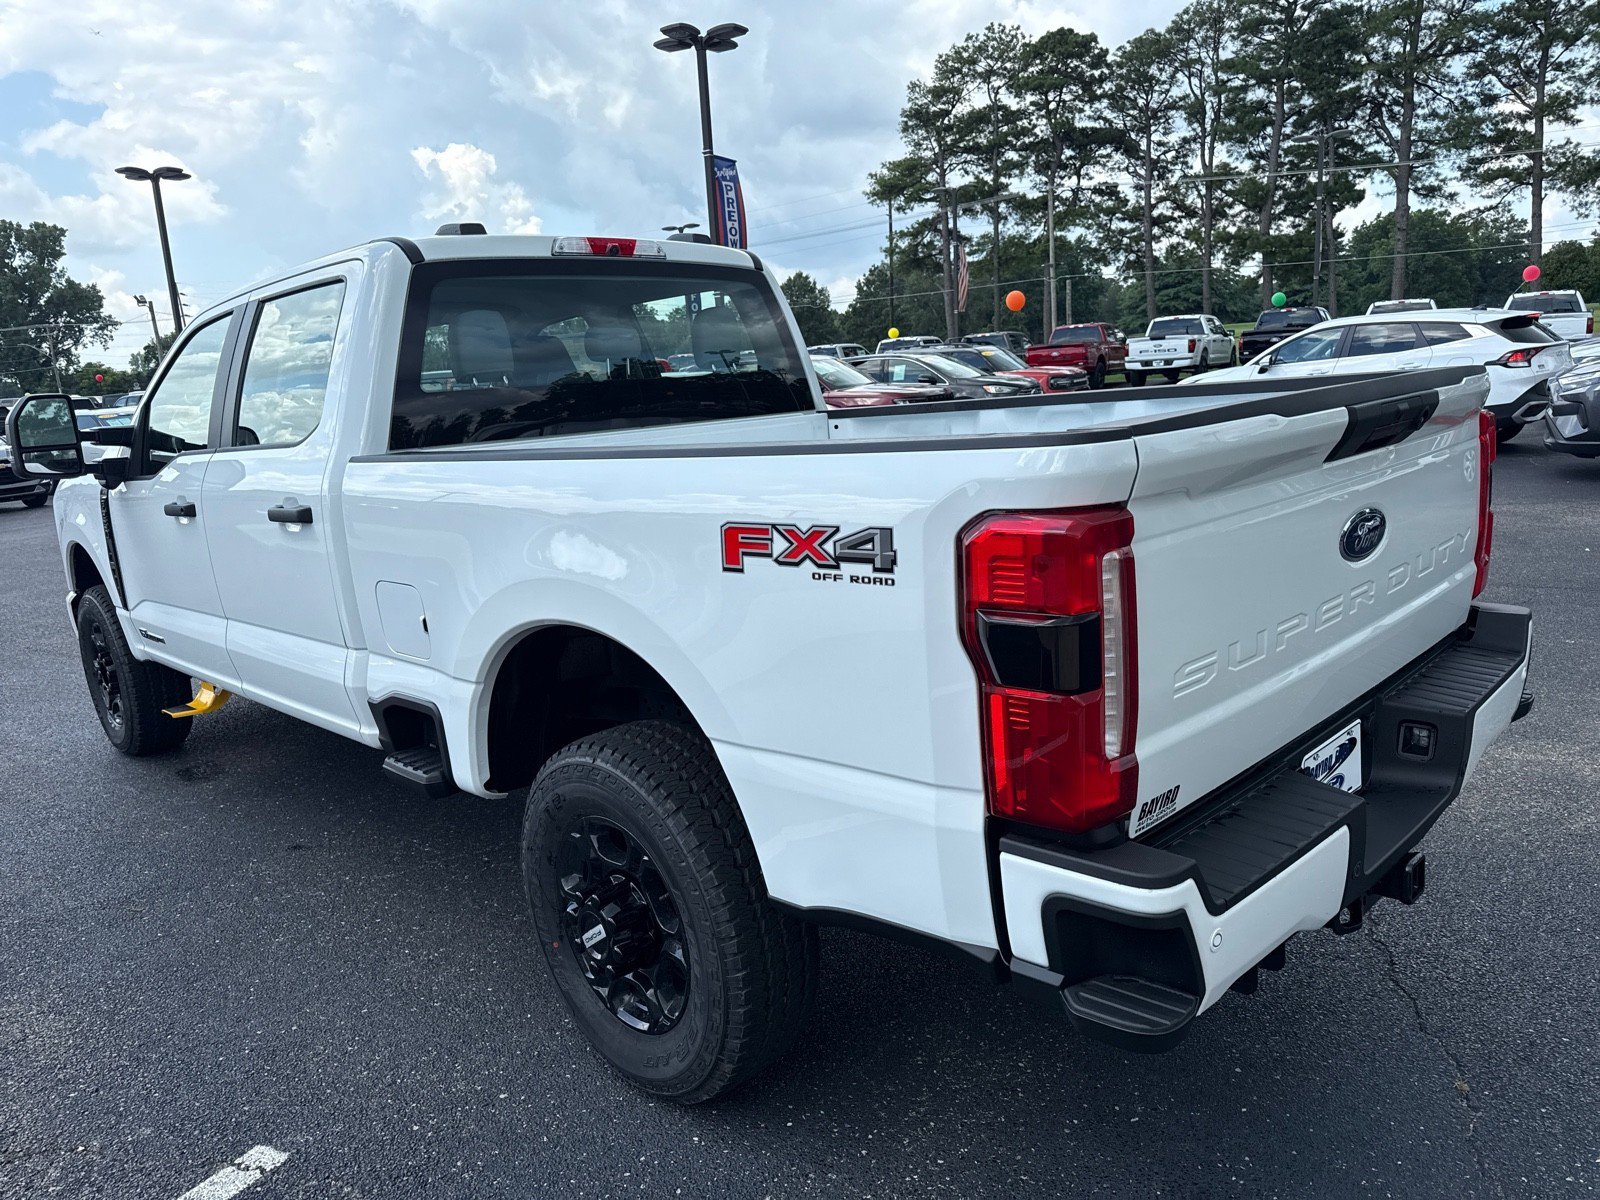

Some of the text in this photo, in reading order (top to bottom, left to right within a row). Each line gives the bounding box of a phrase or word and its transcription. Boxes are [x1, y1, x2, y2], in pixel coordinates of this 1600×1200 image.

[720, 521, 898, 574] FX4
[1348, 513, 1383, 554] Ford
[811, 572, 896, 587] OFF ROAD
[1173, 527, 1472, 700] SUPER DUTY
[1137, 784, 1181, 822] BAYIRD
